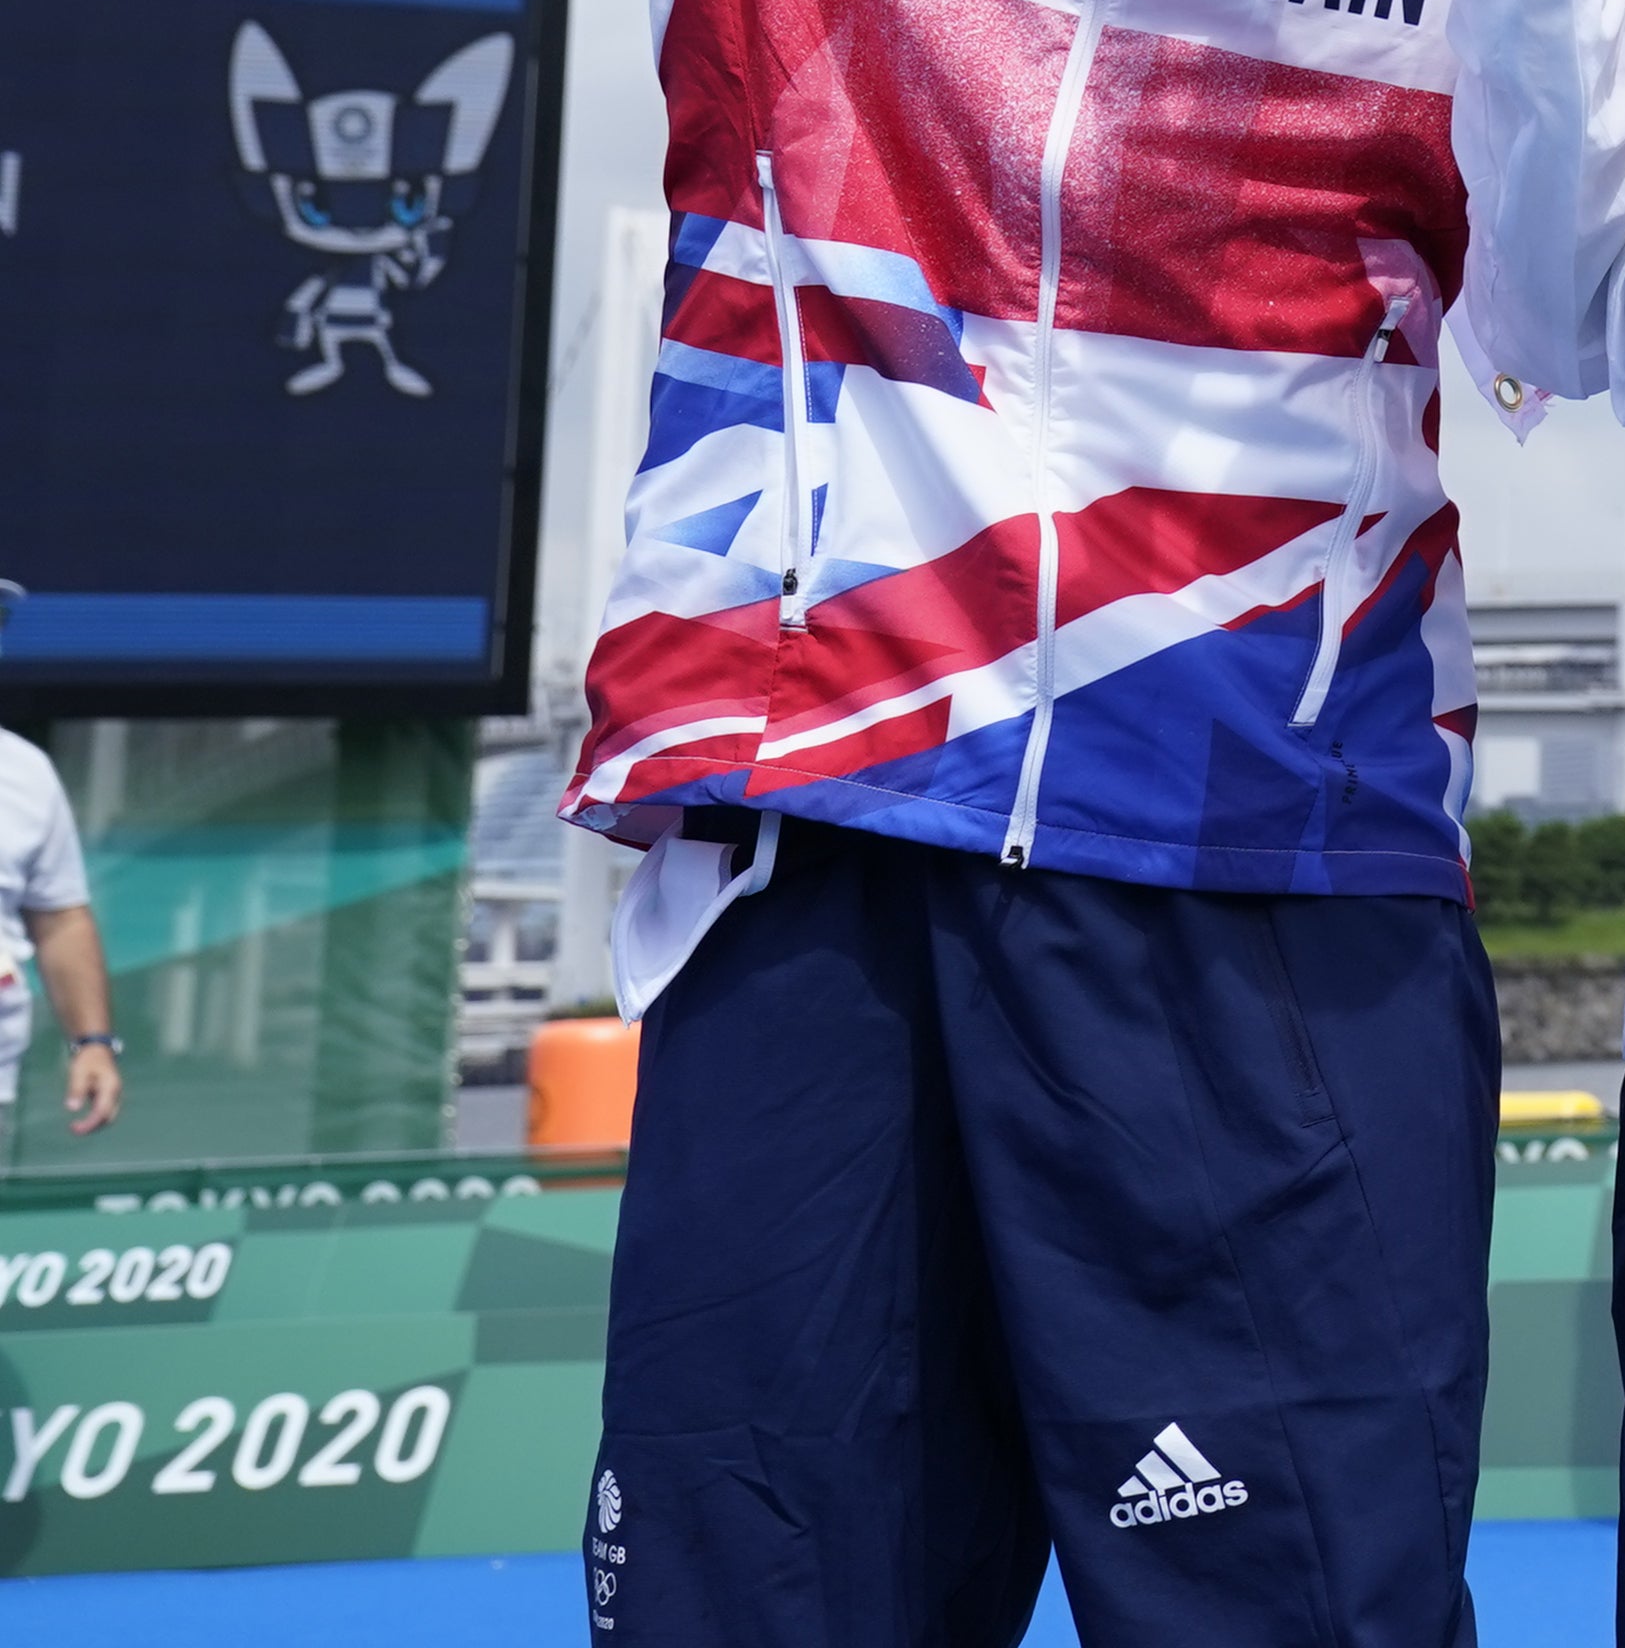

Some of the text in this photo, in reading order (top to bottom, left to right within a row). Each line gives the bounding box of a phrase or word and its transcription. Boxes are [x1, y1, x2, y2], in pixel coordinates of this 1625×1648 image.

[66, 1243, 232, 1305] 2020
[152, 1385, 451, 1496] 2020
[1108, 1476, 1249, 1529] adidas
[608, 1545, 626, 1565] GB
